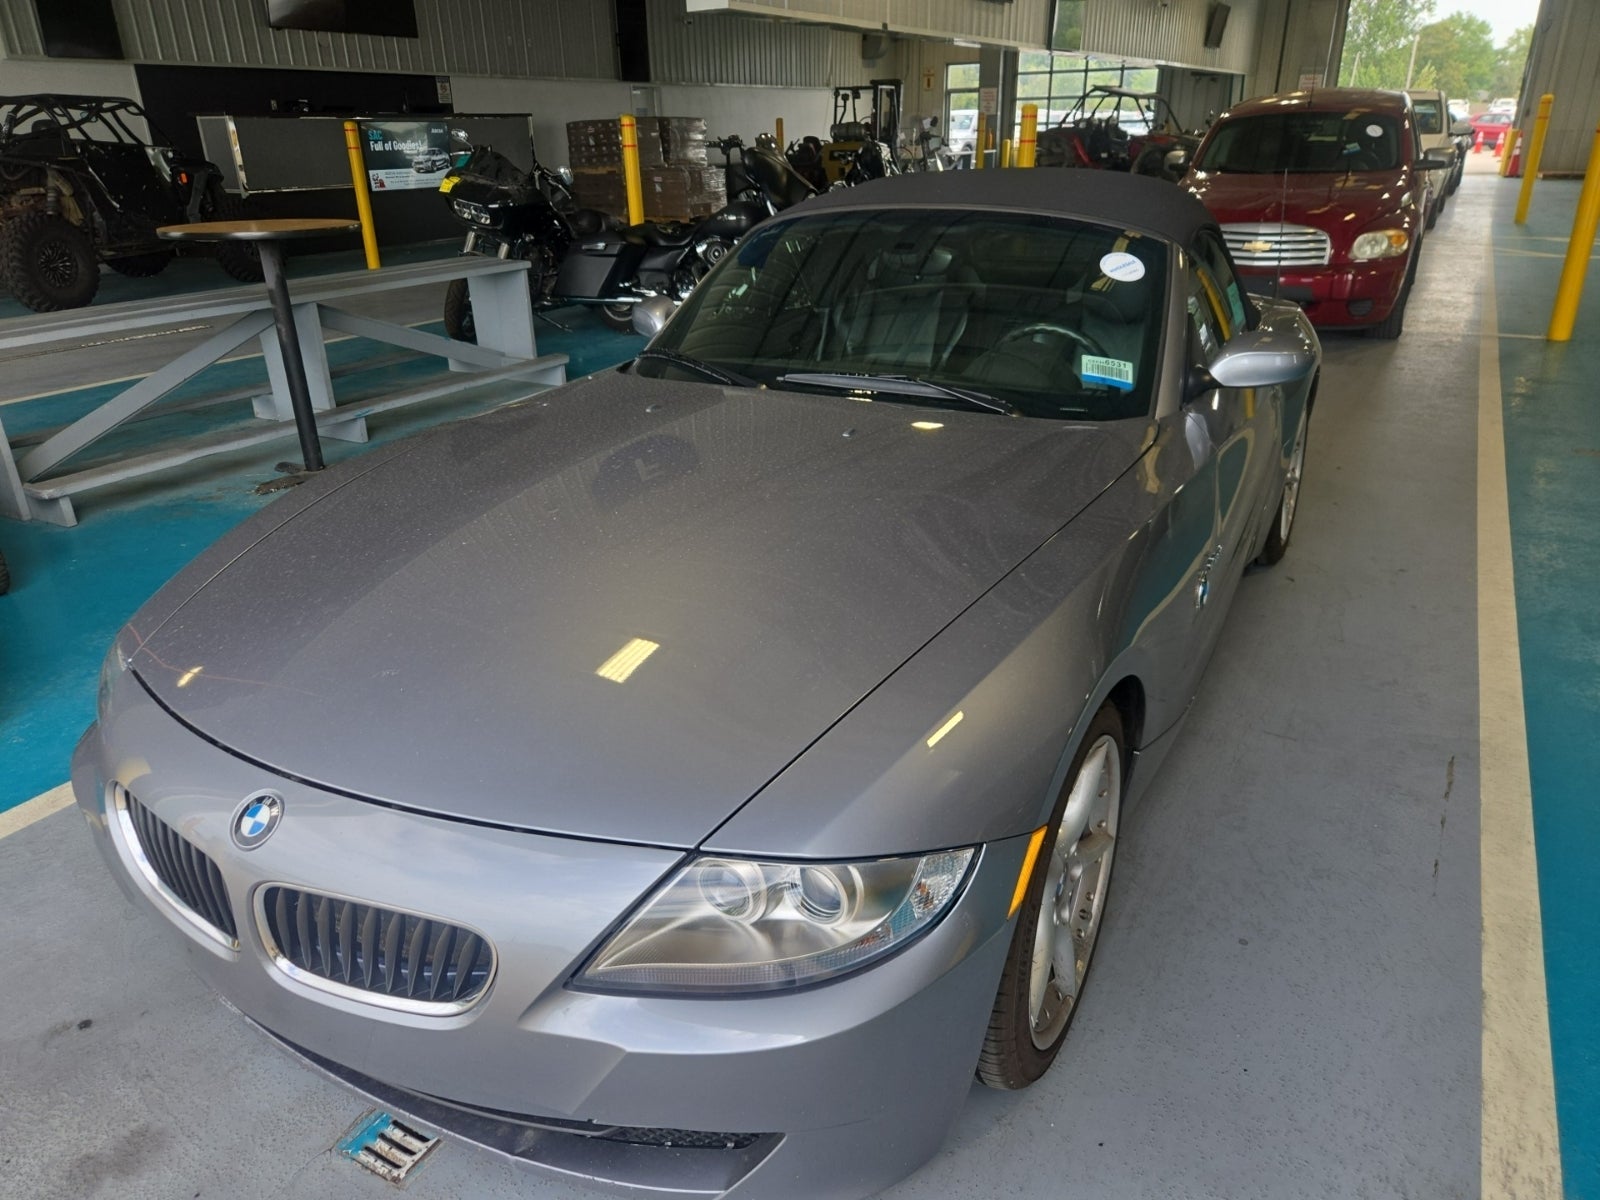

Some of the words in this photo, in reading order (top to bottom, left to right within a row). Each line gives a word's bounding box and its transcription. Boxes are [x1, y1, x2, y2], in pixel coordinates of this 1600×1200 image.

[368, 130, 383, 140] SAC
[370, 140, 384, 151] Full
[384, 141, 392, 150] of
[393, 139, 422, 151] Goodies!
